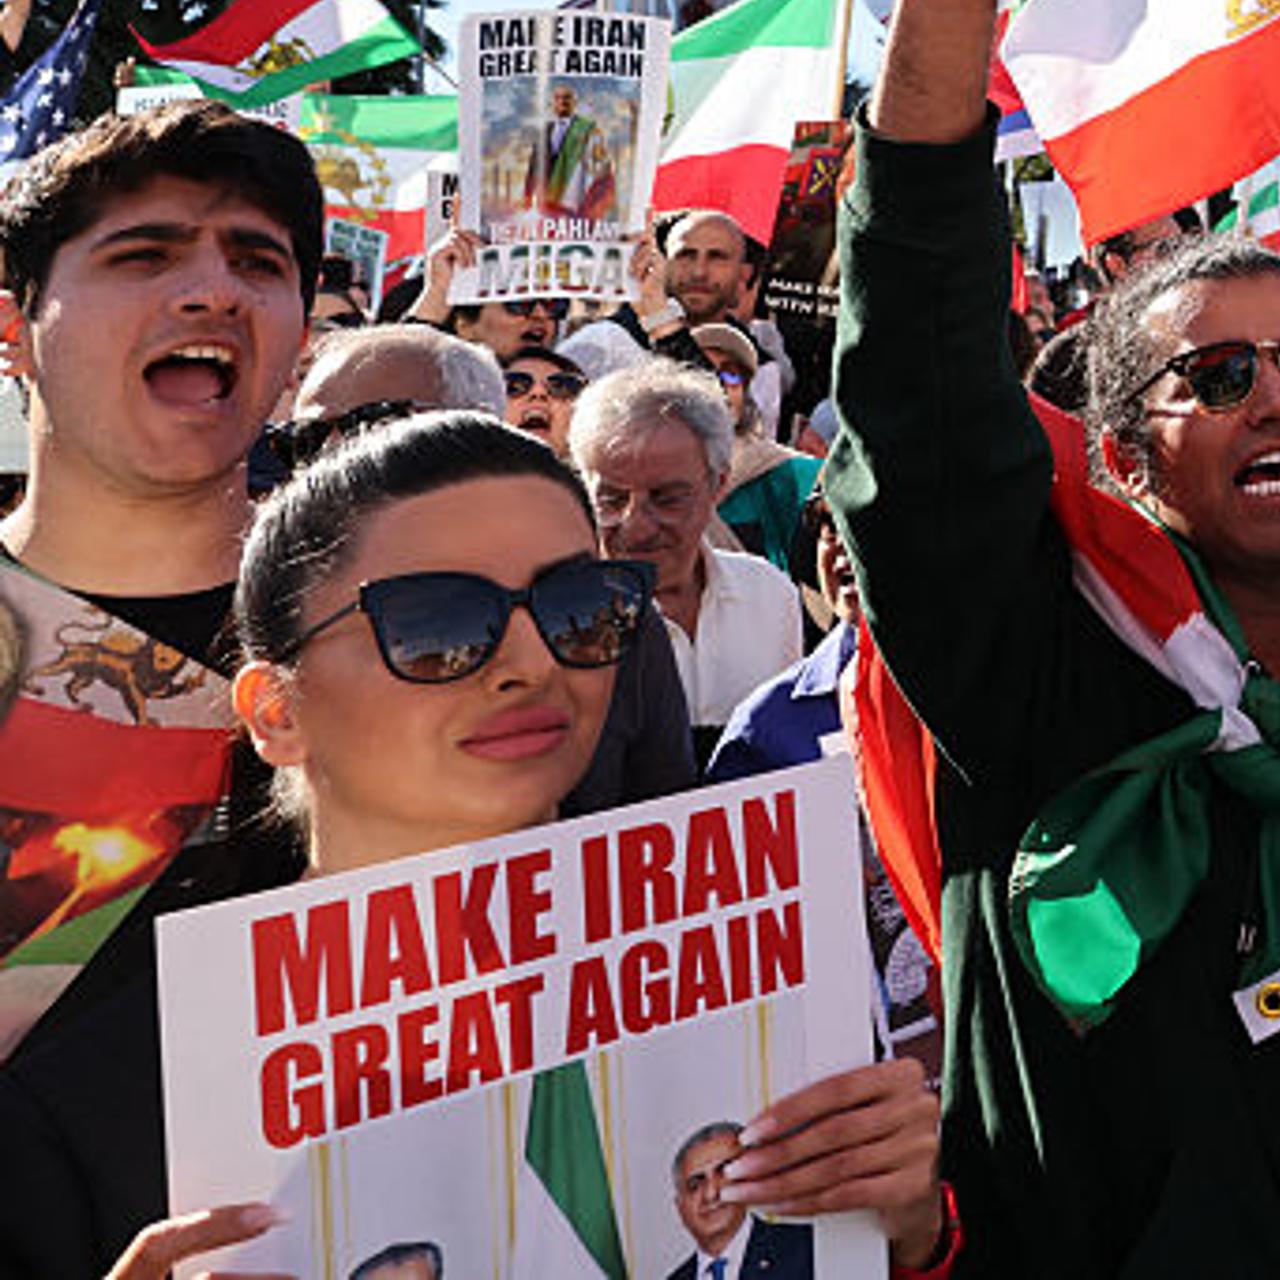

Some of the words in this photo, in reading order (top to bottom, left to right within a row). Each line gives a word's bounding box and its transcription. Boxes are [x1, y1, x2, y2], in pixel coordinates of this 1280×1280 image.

[573, 16, 647, 51] IRAN
[565, 49, 644, 78] AGAIN
[477, 243, 627, 298] MIGA
[250, 848, 557, 1037] MAKE
[581, 789, 801, 943] IRAN
[259, 973, 545, 1150] GREAT
[565, 900, 805, 1056] AGAIN
